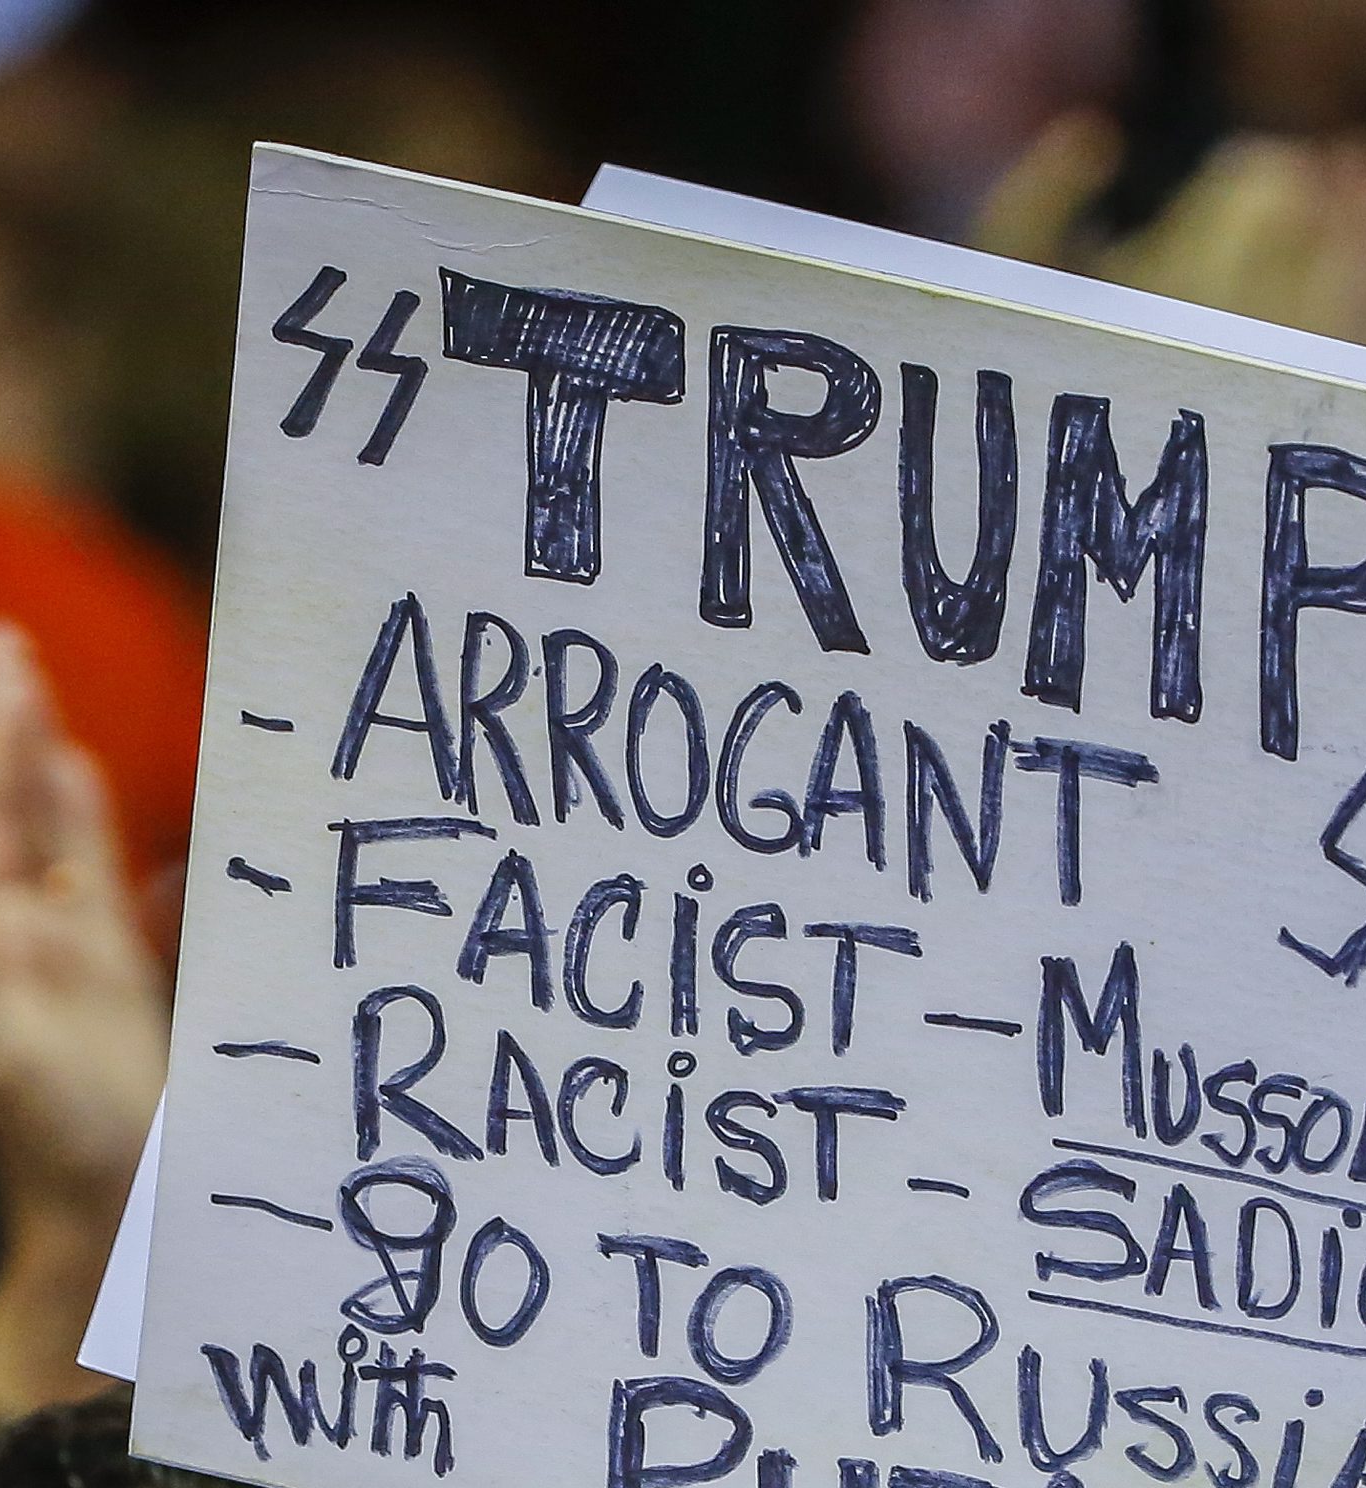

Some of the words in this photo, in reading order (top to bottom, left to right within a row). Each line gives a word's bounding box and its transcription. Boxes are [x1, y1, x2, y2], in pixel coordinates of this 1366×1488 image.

[330, 591, 1159, 906] ARROGANT
[597, 1233, 790, 1385] TO
[200, 1324, 457, 1478] with
